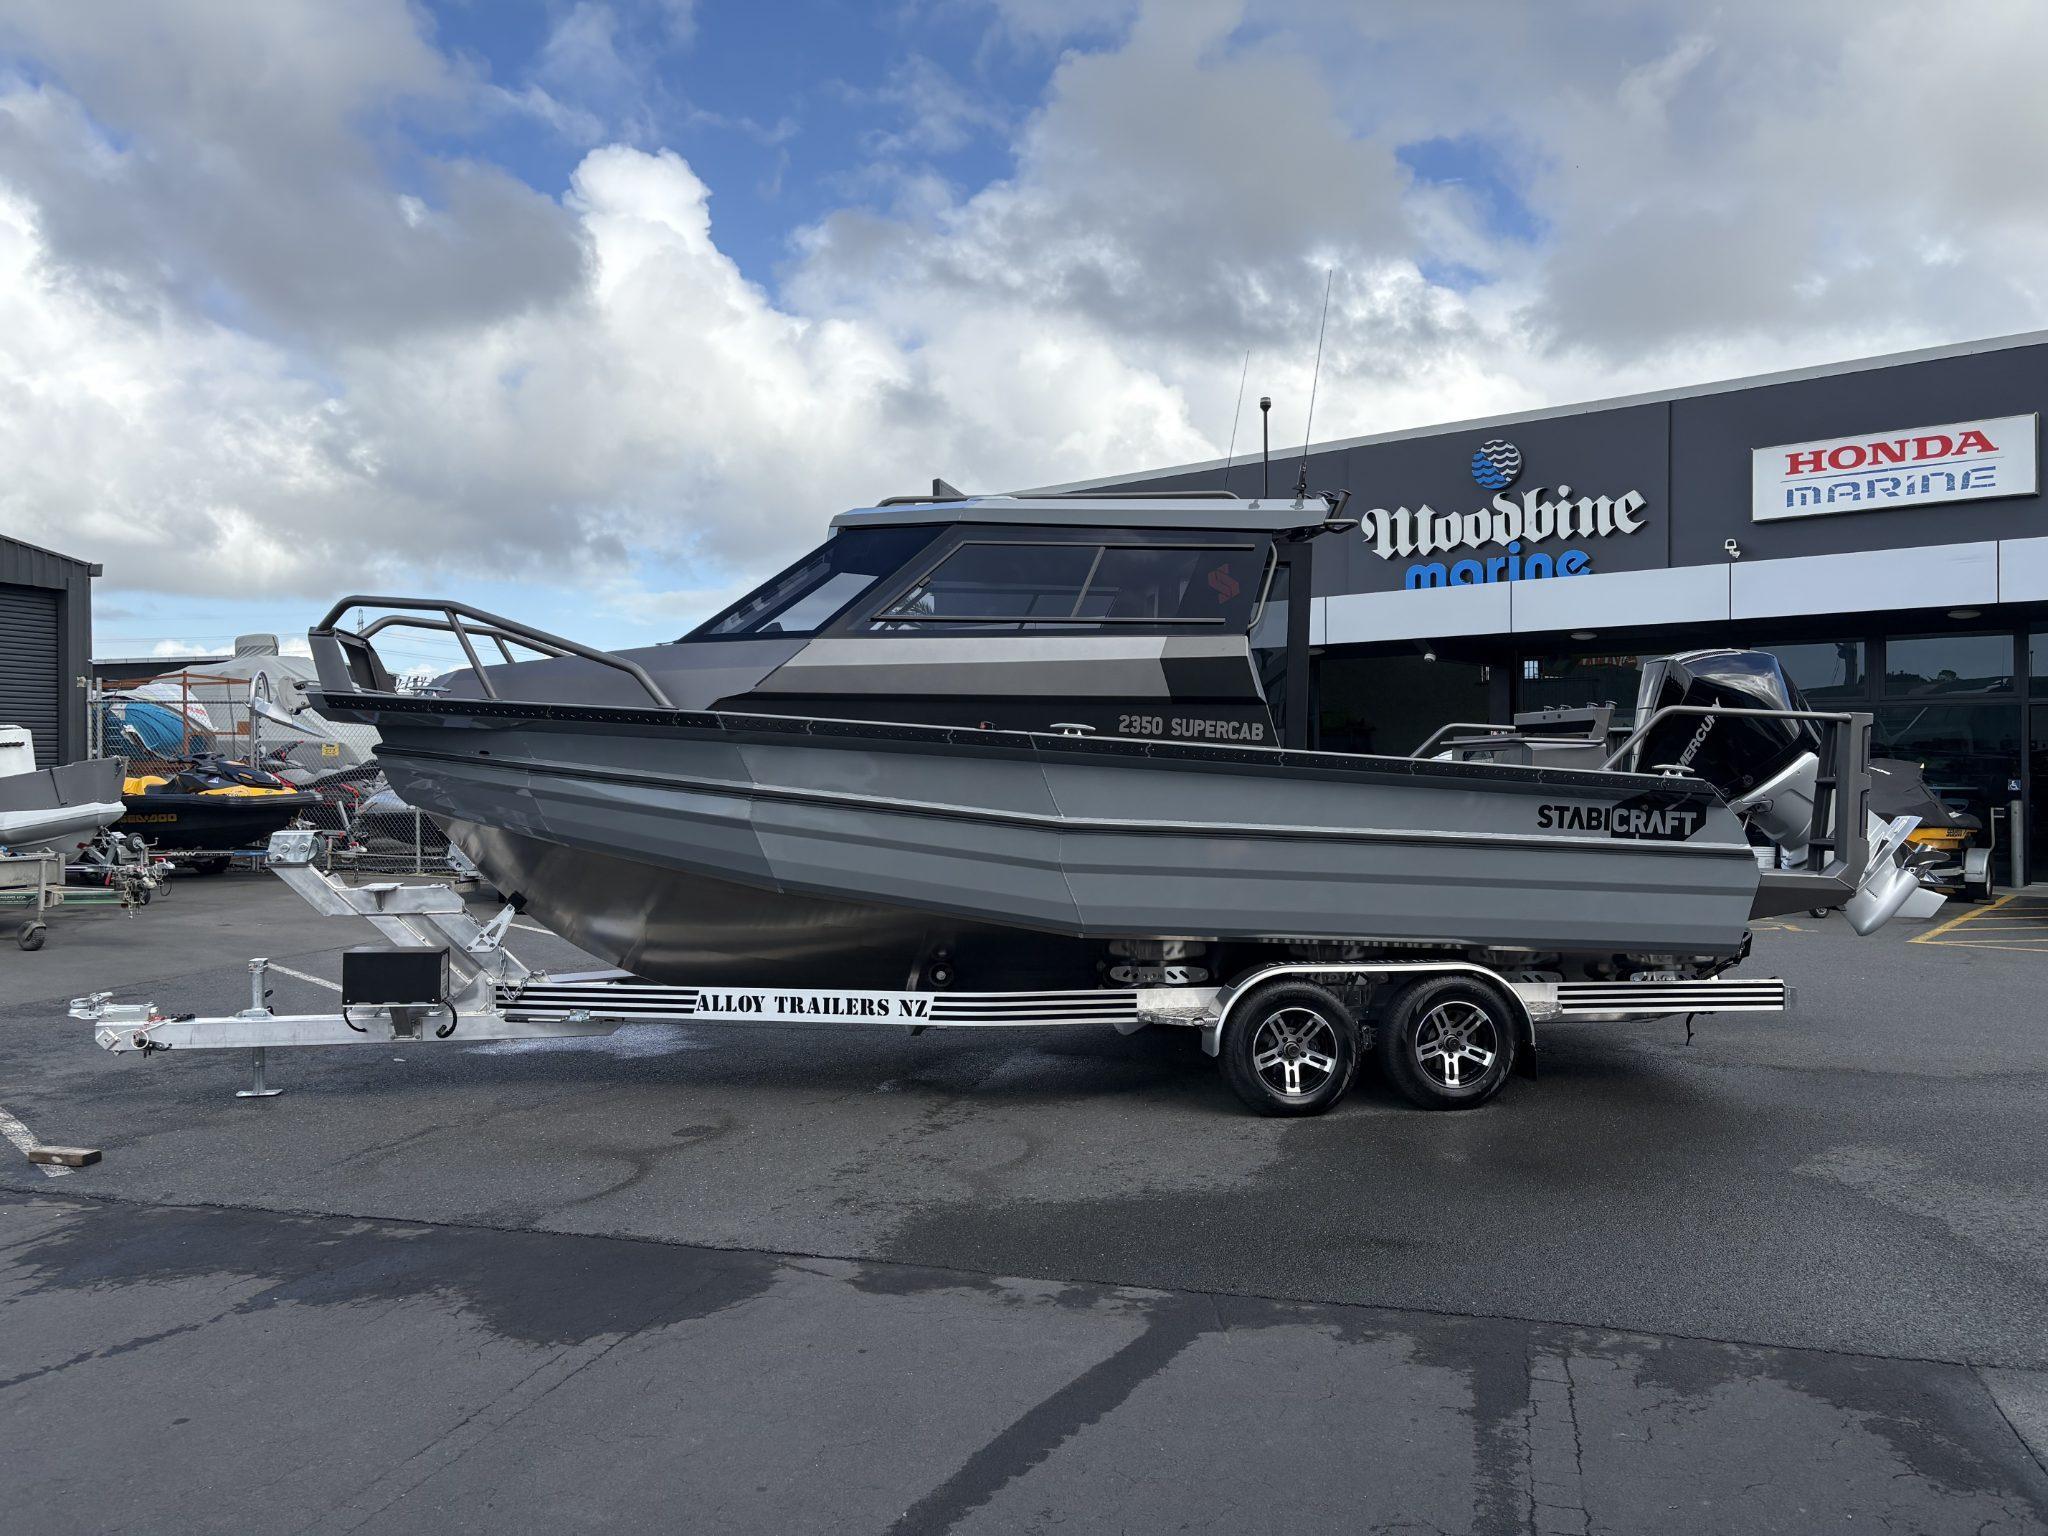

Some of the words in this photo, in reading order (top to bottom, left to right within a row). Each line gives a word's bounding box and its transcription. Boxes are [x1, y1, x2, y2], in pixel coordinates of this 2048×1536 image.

[1786, 430, 1999, 475] HONDA
[1361, 484, 1647, 560] Woodbine
[1405, 541, 1592, 590] marine
[1119, 715, 1163, 735] 2350
[1171, 717, 1264, 740] SUPERCAB
[1674, 696, 1722, 769] MERCU
[1537, 804, 1697, 836] STABICRAFT
[696, 994, 764, 1013] ALLOY
[774, 996, 889, 1017] TRAILERS
[899, 1000, 927, 1017] NZ
